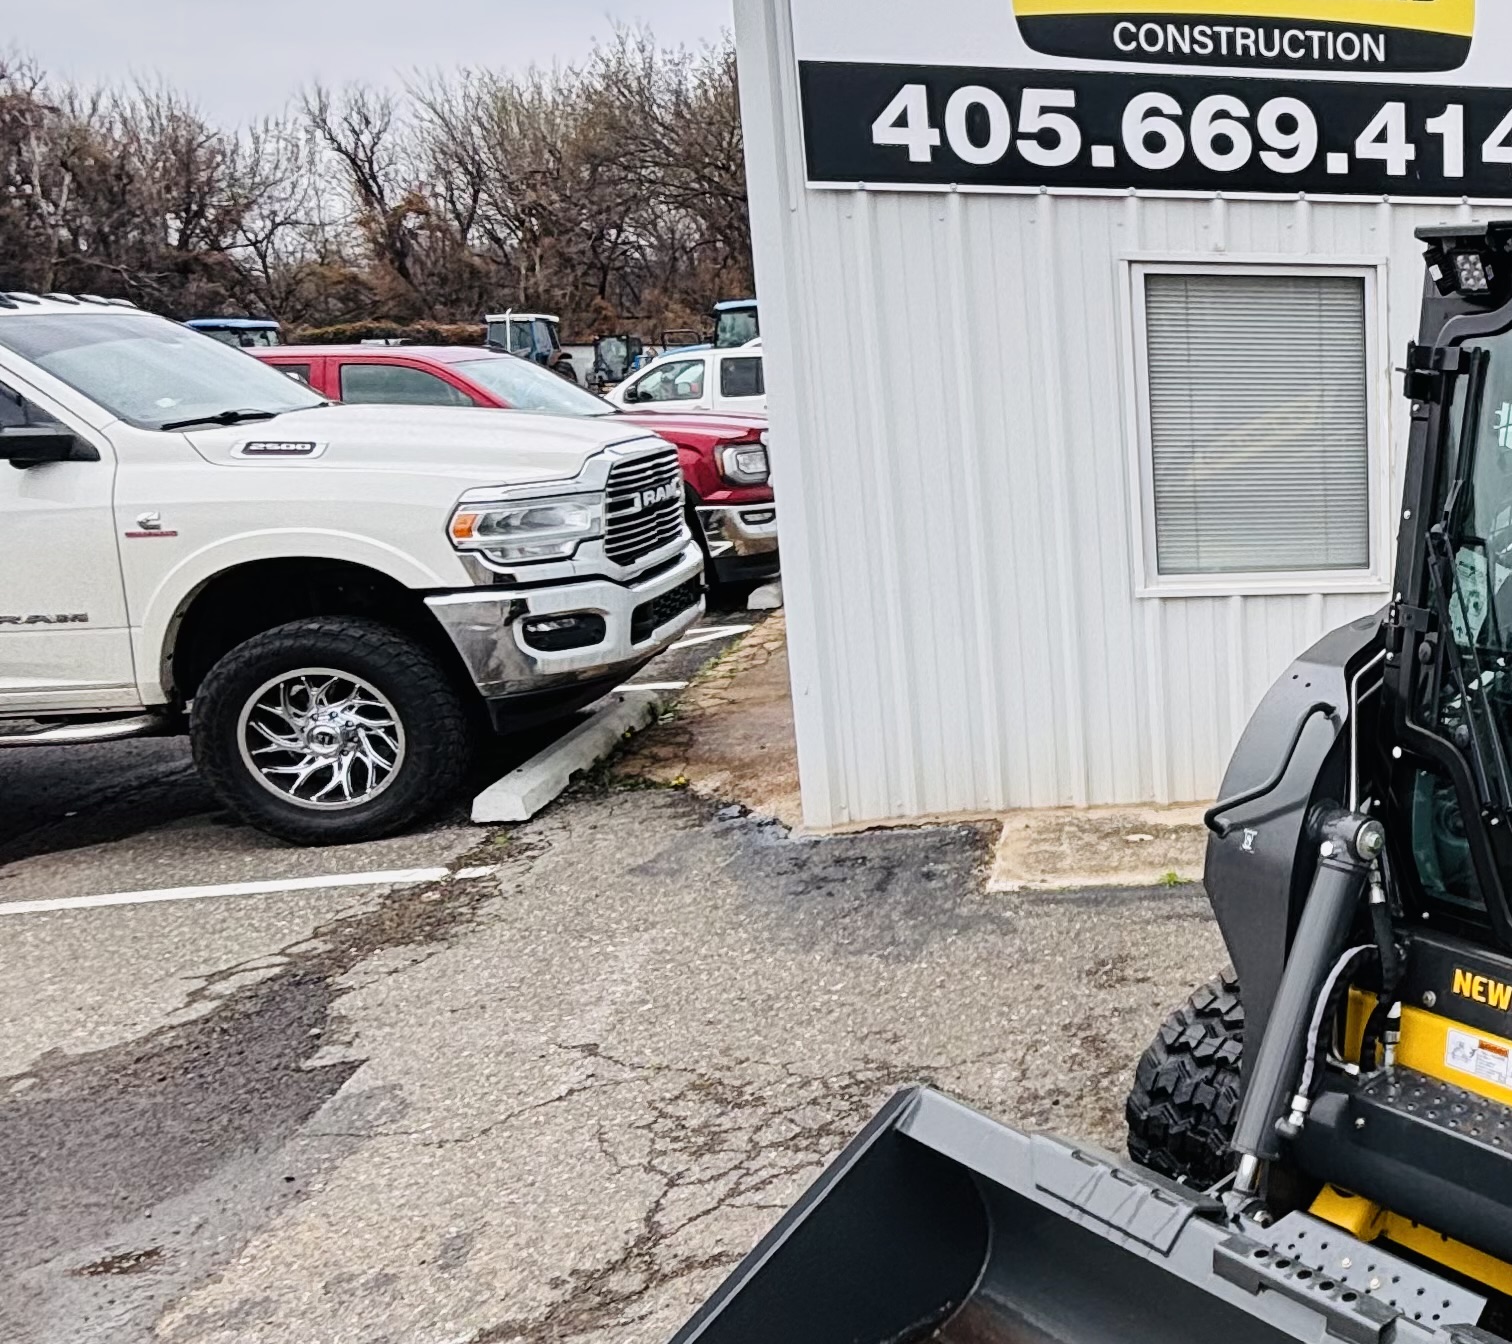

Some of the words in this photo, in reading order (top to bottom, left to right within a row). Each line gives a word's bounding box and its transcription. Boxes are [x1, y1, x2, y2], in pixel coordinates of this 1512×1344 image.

[1112, 21, 1386, 62] CONSTRUCTION
[249, 442, 312, 451] 2500
[1452, 968, 1512, 1011] NEW
